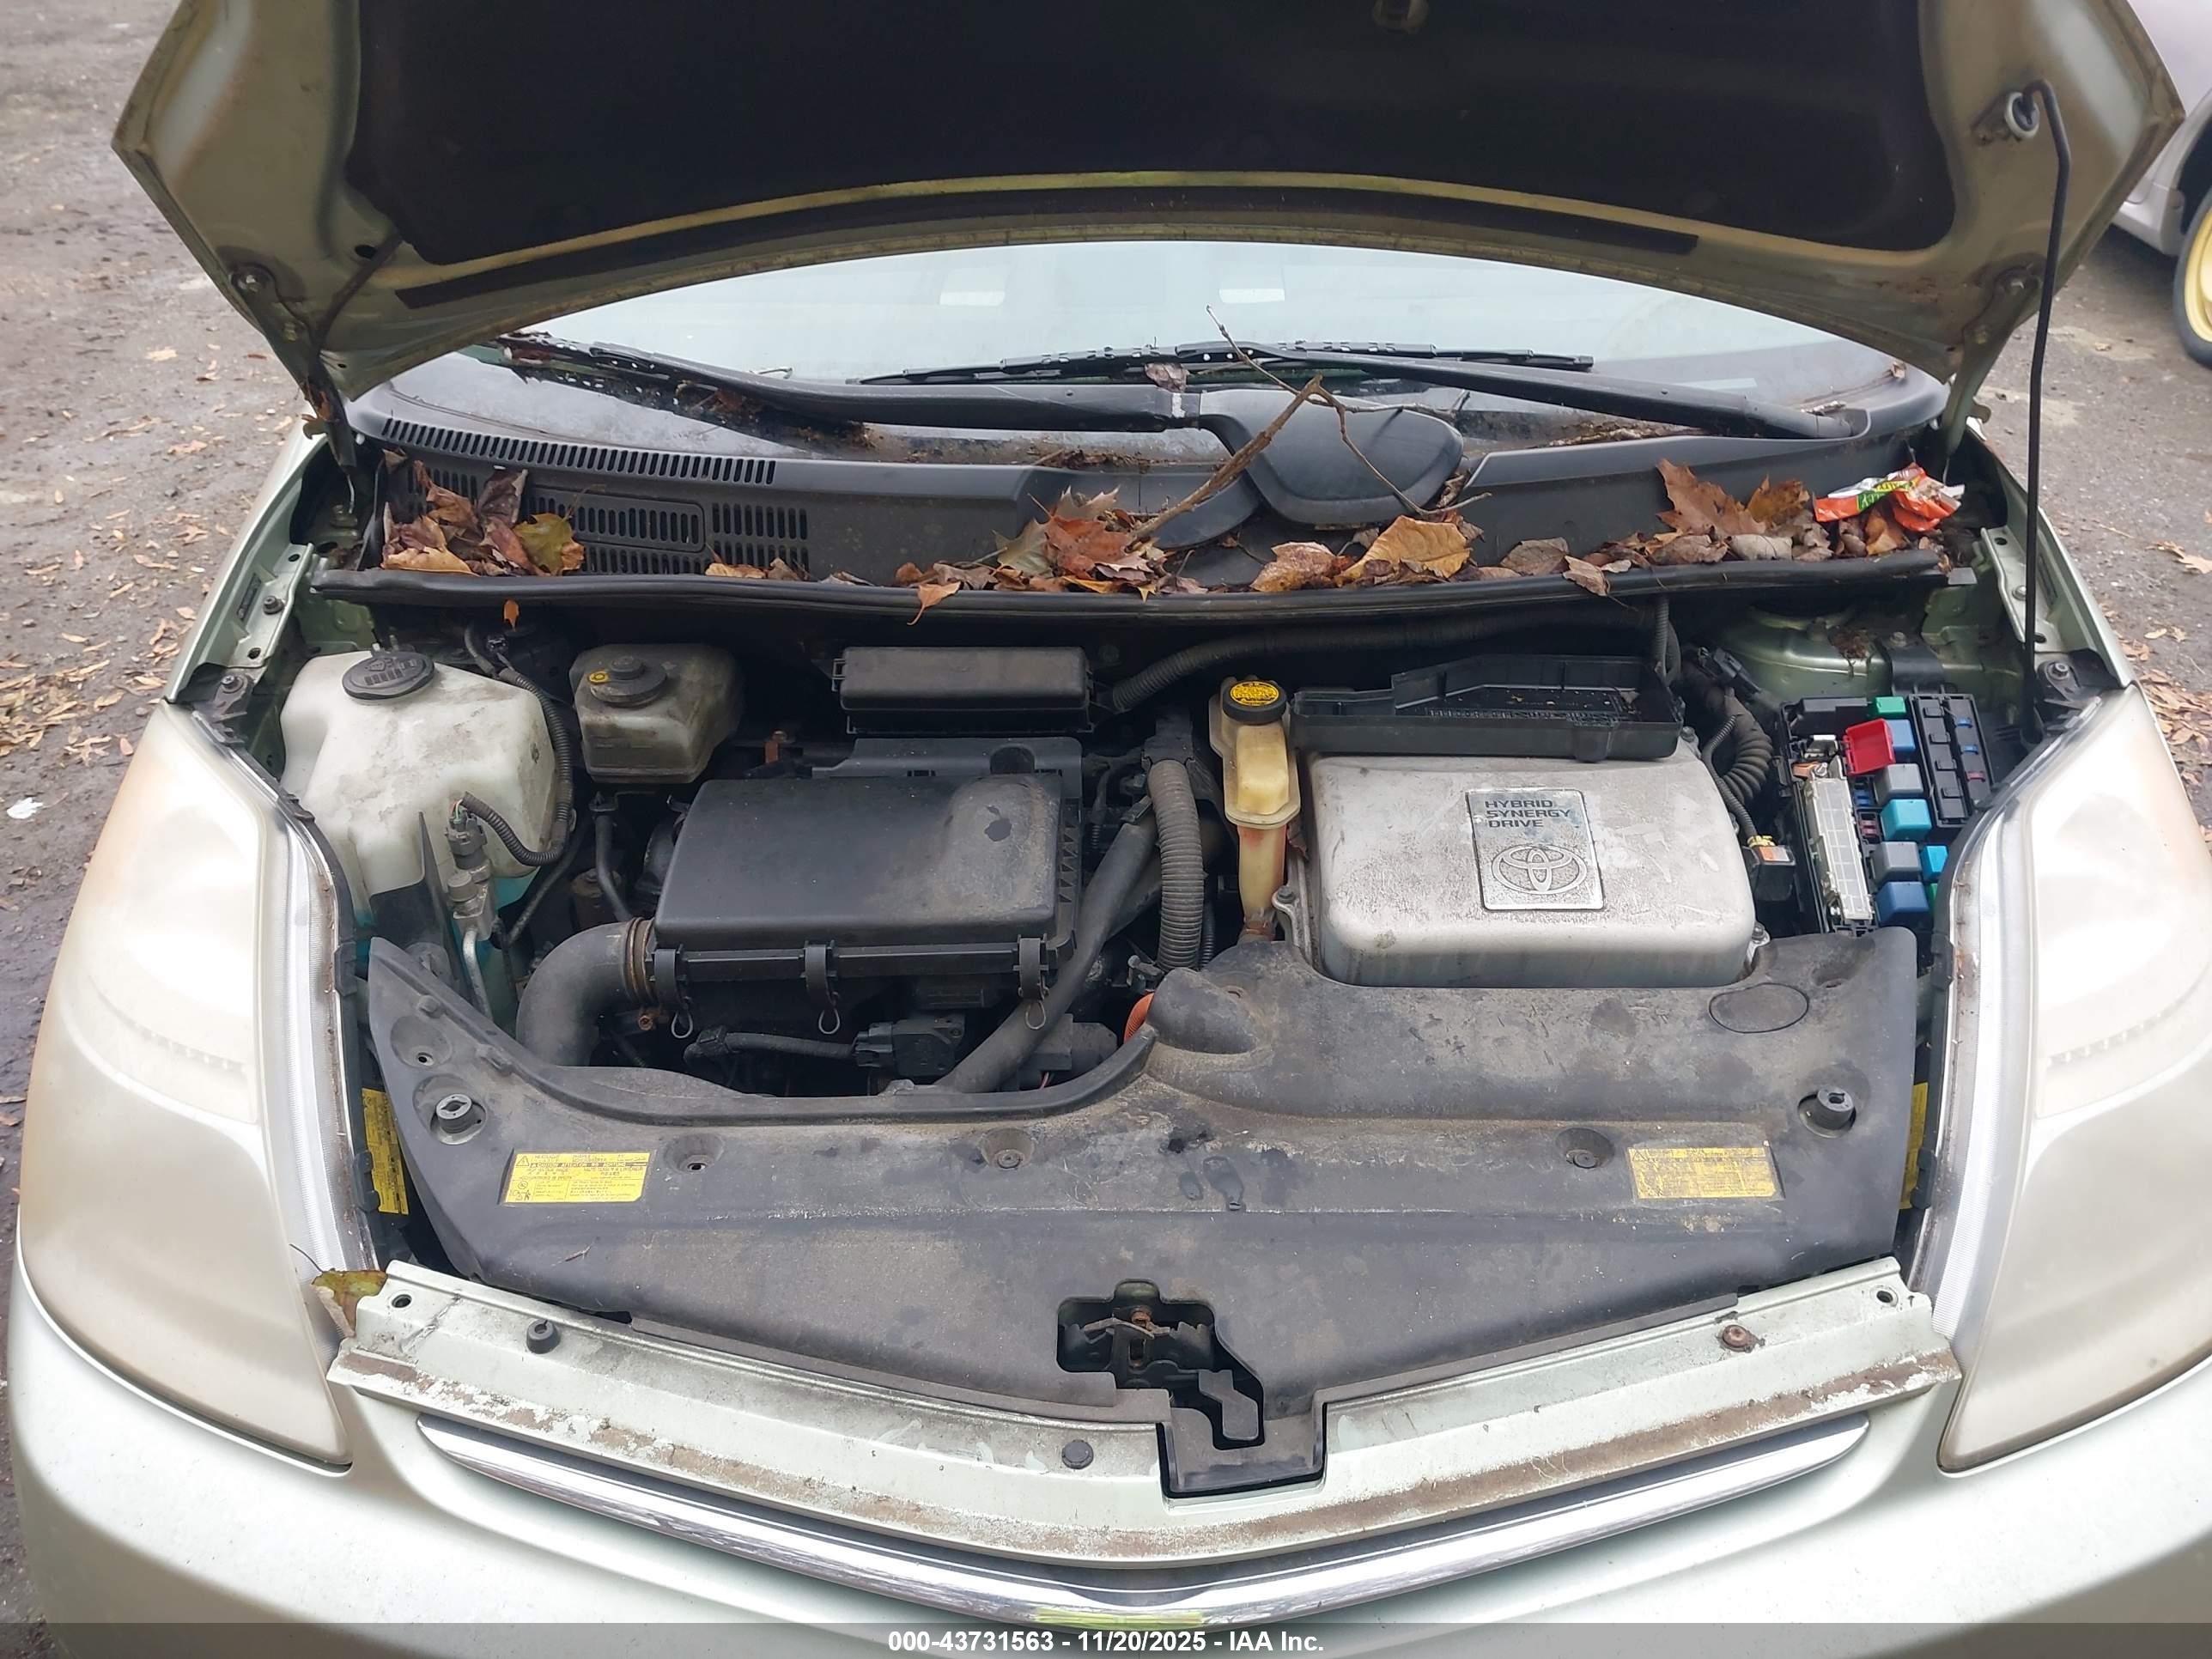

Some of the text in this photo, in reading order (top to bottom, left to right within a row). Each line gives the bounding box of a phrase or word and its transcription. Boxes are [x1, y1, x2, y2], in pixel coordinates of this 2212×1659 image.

[1484, 799, 1553, 808] HYBRID
[1486, 810, 1571, 818] SYNERGY
[1488, 819, 1544, 828] DRIVE
